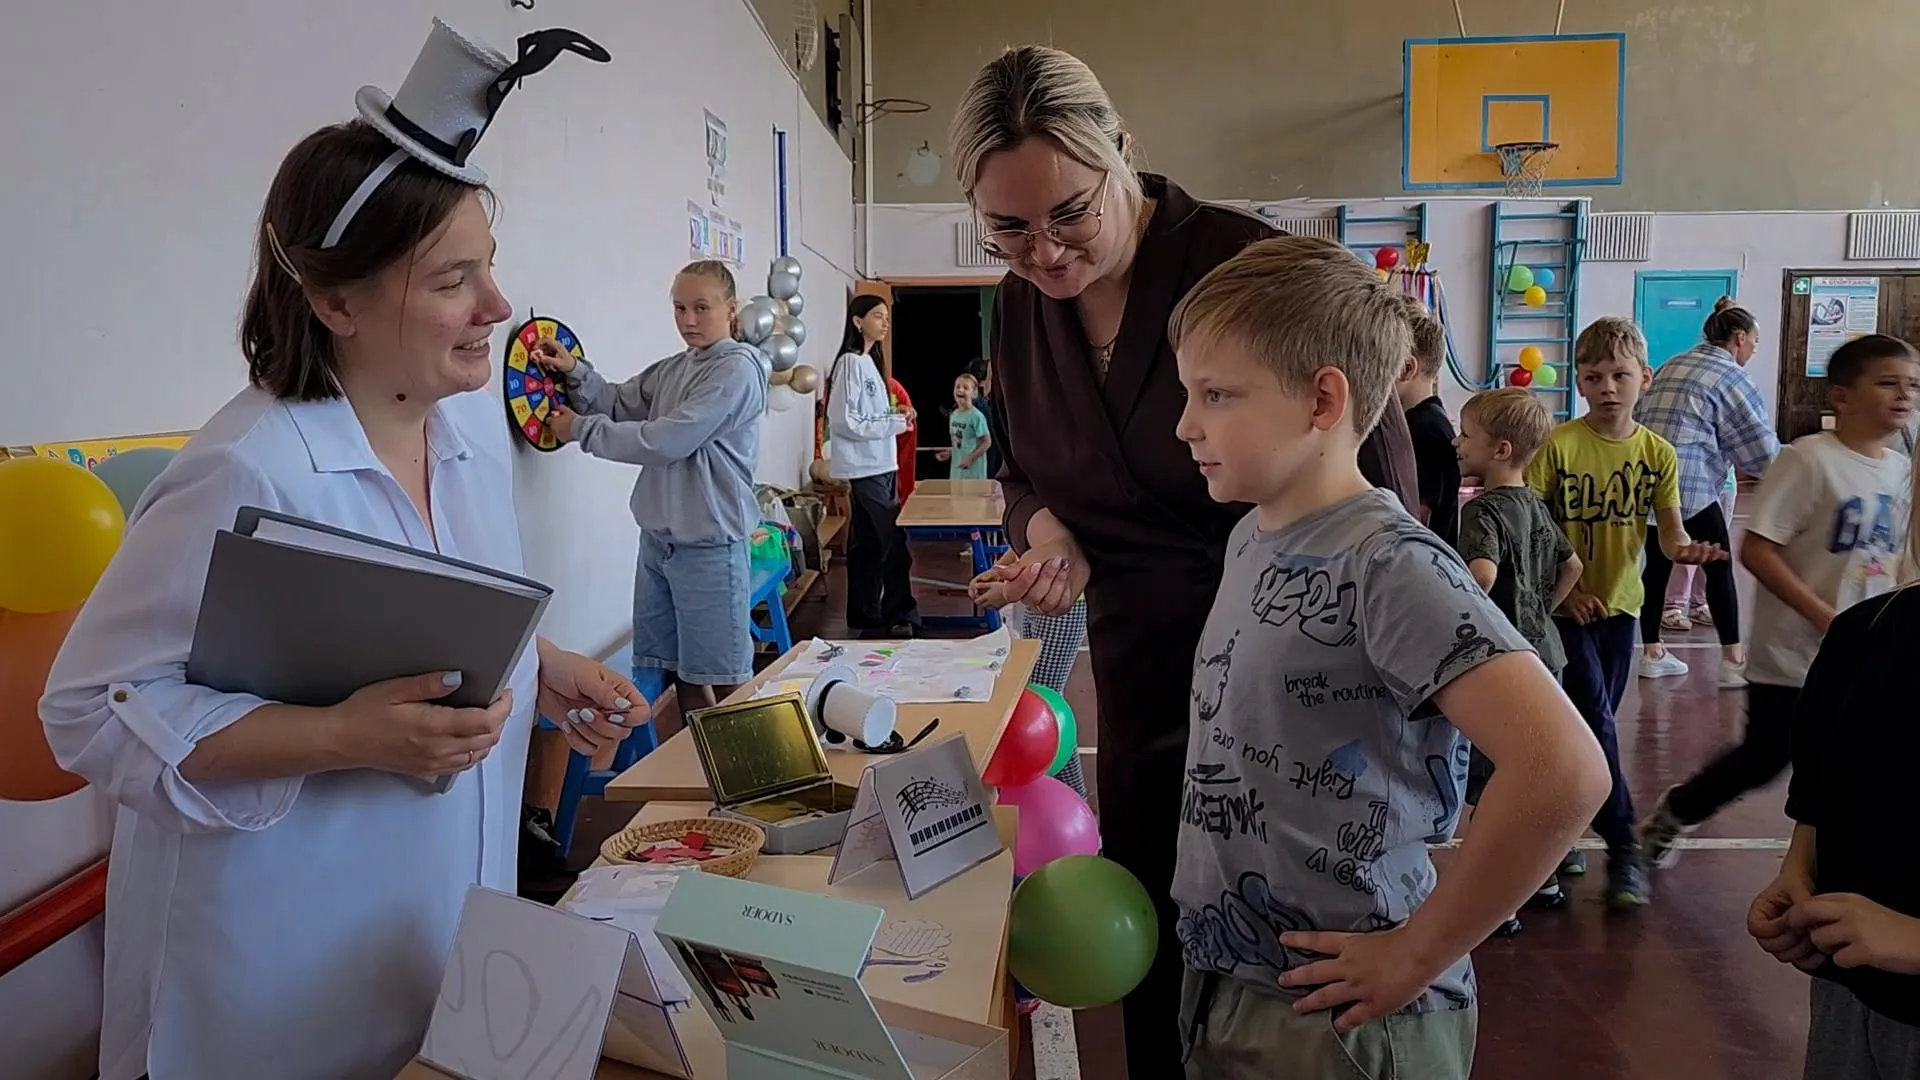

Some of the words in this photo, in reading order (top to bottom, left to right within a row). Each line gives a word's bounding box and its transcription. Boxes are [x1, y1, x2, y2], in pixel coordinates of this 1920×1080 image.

[513, 351, 526, 363] 20
[509, 378, 520, 390] 10
[1283, 671, 1330, 694] break
[1297, 689, 1325, 708] the
[1332, 682, 1387, 702] routine
[1212, 727, 1235, 750] are
[1242, 744, 1283, 774] you
[1289, 758, 1357, 801] Right
[1305, 847, 1329, 873] A
[741, 903, 796, 926] SADOER
